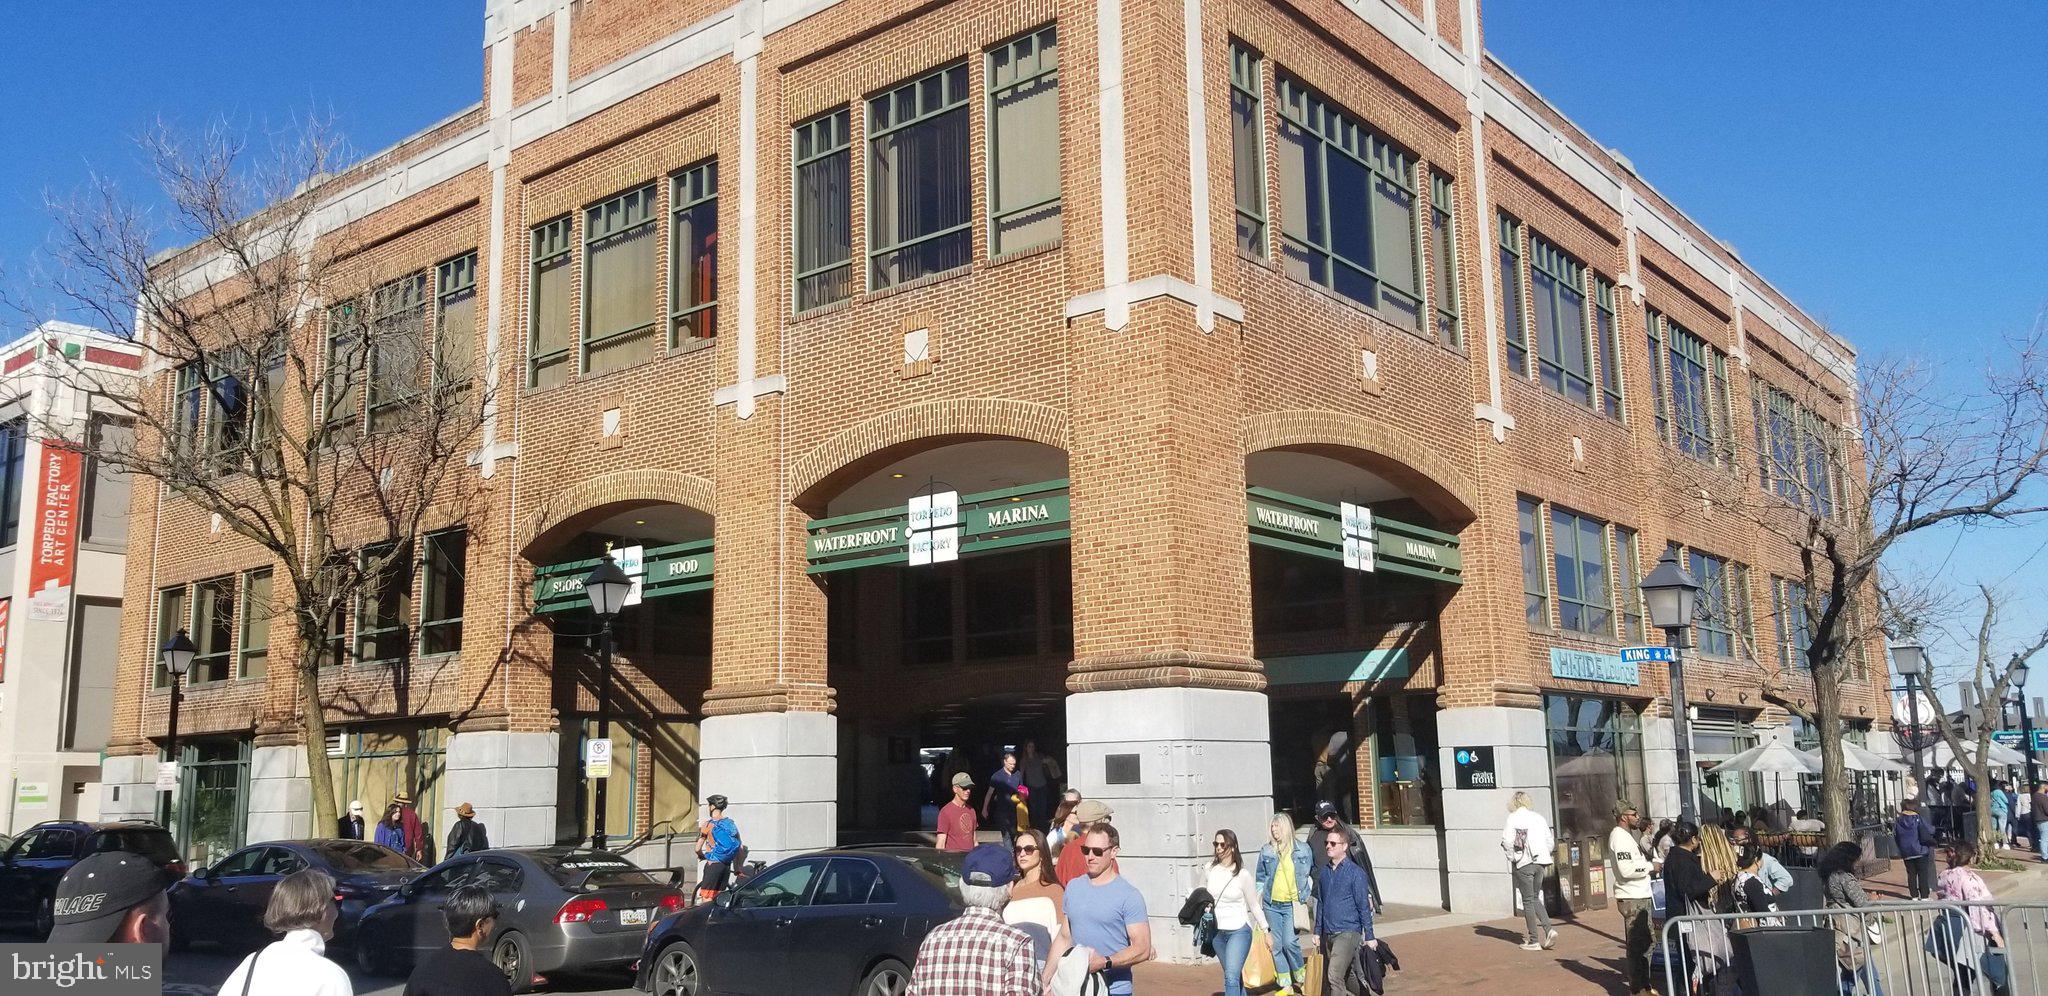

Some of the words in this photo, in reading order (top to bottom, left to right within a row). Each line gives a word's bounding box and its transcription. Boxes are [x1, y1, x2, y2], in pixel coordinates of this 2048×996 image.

[46, 453, 62, 507] FACTORY
[57, 484, 71, 536] CENTER
[814, 527, 898, 553] WATERFRONT
[988, 504, 1049, 528] MARINA
[910, 506, 953, 522] TORPEDO
[1256, 507, 1320, 536] WATERFRONT
[1406, 541, 1437, 561] MARINA
[41, 510, 56, 565] TORPEDO
[54, 540, 66, 566] ART
[553, 577, 584, 593] SHOPS
[669, 559, 699, 576] FOOD
[1625, 648, 1650, 661] KING
